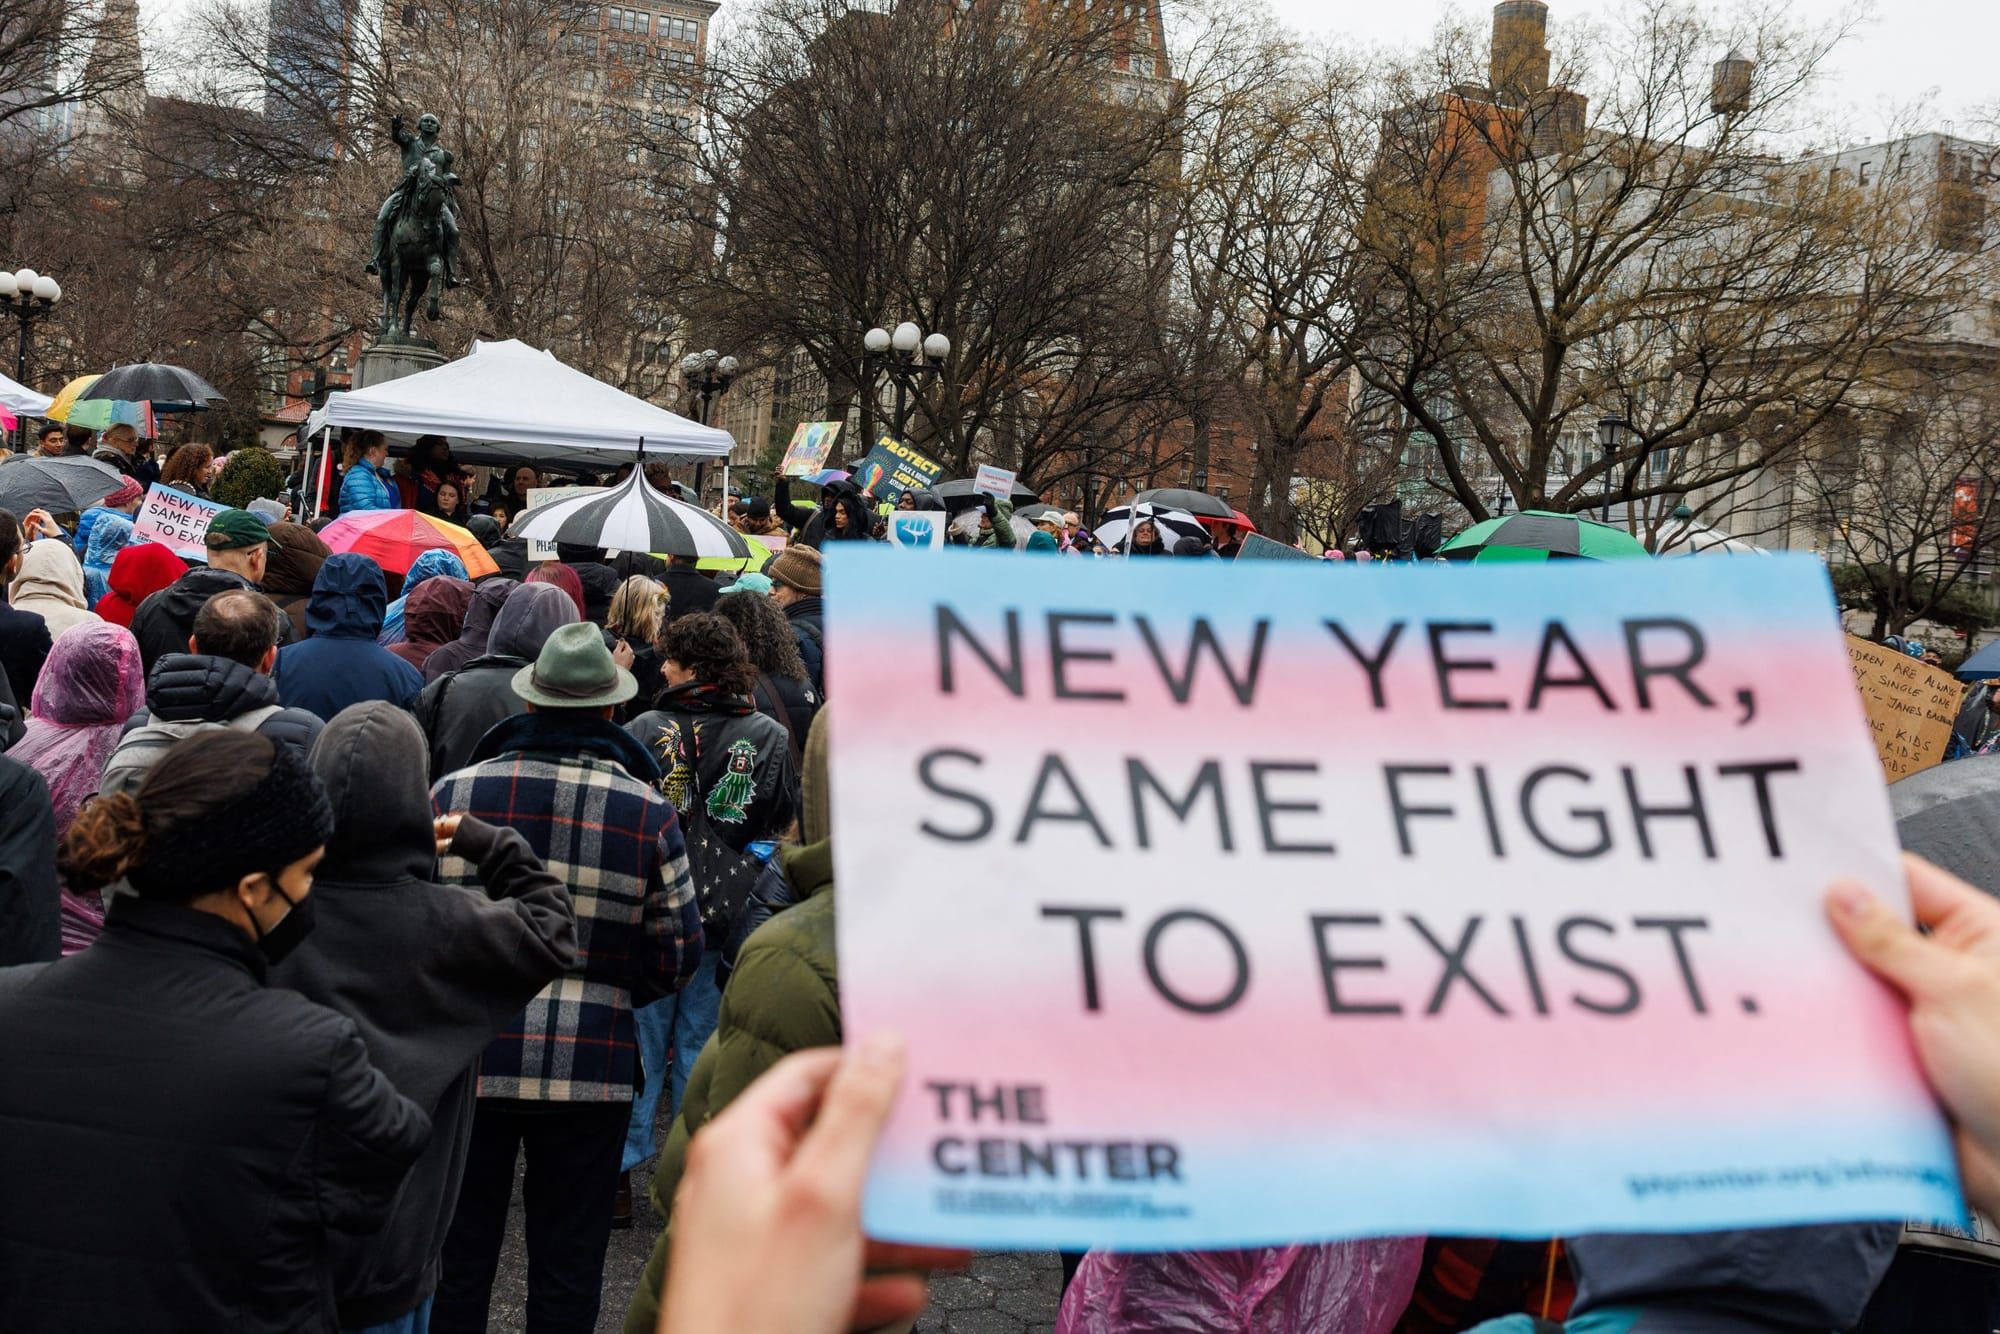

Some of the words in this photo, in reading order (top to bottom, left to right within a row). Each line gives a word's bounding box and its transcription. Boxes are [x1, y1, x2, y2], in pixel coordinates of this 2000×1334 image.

[878, 435, 940, 476] PROTECT
[149, 503, 191, 527] SAME
[193, 520, 208, 532] FI
[157, 490, 194, 511] NEW
[198, 504, 217, 518] YE
[155, 520, 175, 536] TO
[536, 540, 558, 553] PFLAG
[935, 602, 1271, 707] NEW
[1321, 616, 1757, 726] YEAR,
[1893, 662, 1916, 679] ARE
[1878, 674, 1923, 697] SINGLE
[1931, 695, 1950, 709] ONE
[1885, 740, 1921, 762] KIDS
[1895, 729, 1932, 751] KIDS
[917, 746, 1336, 855] SAME
[1381, 757, 1801, 861] FIGHT
[1039, 903, 1251, 1016] TO
[1309, 913, 1760, 1019] EXIST.
[926, 1080, 1048, 1125] THE
[932, 1137, 1183, 1182] CENTER
